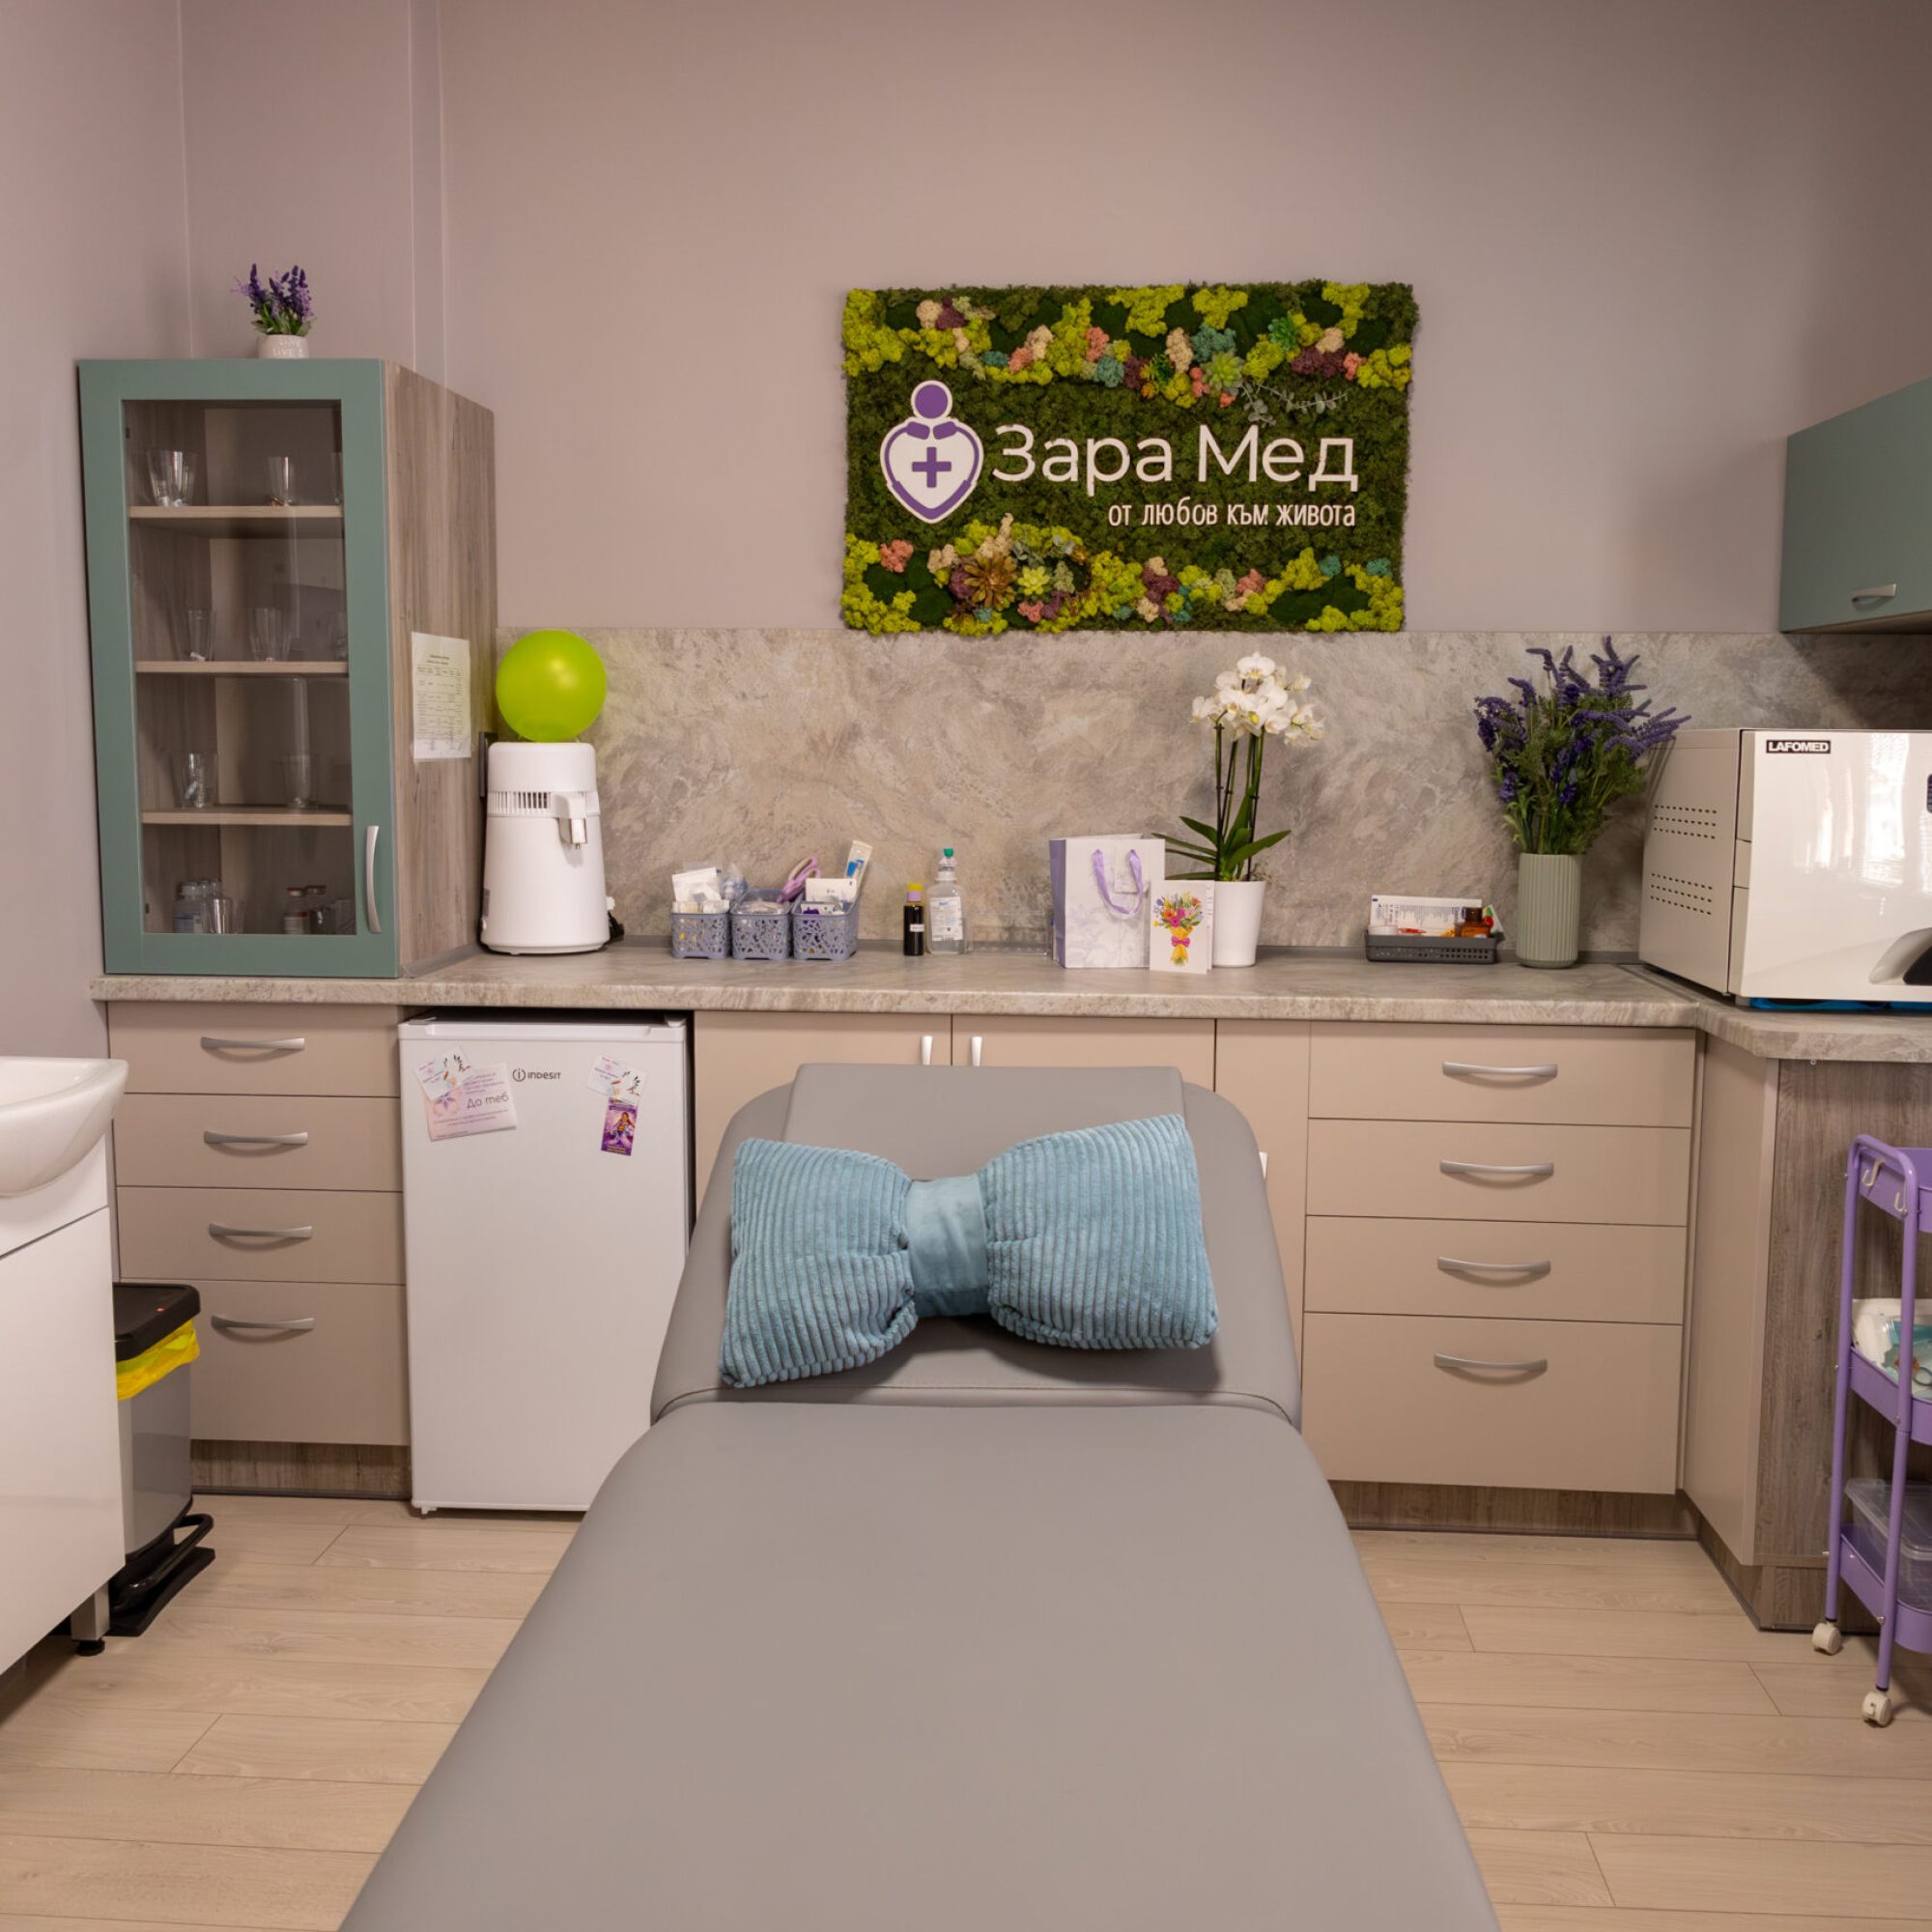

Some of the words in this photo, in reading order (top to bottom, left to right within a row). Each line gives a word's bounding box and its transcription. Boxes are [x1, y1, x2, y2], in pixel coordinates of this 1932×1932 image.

[992, 424, 1172, 497] Зара
[1198, 424, 1358, 492] Мед
[1108, 504, 1132, 526] от
[1142, 496, 1217, 526] любов
[1227, 504, 1268, 526] към
[1276, 504, 1355, 526] живота
[1769, 742, 1829, 753] LAFOMED
[467, 1097, 483, 1109] До
